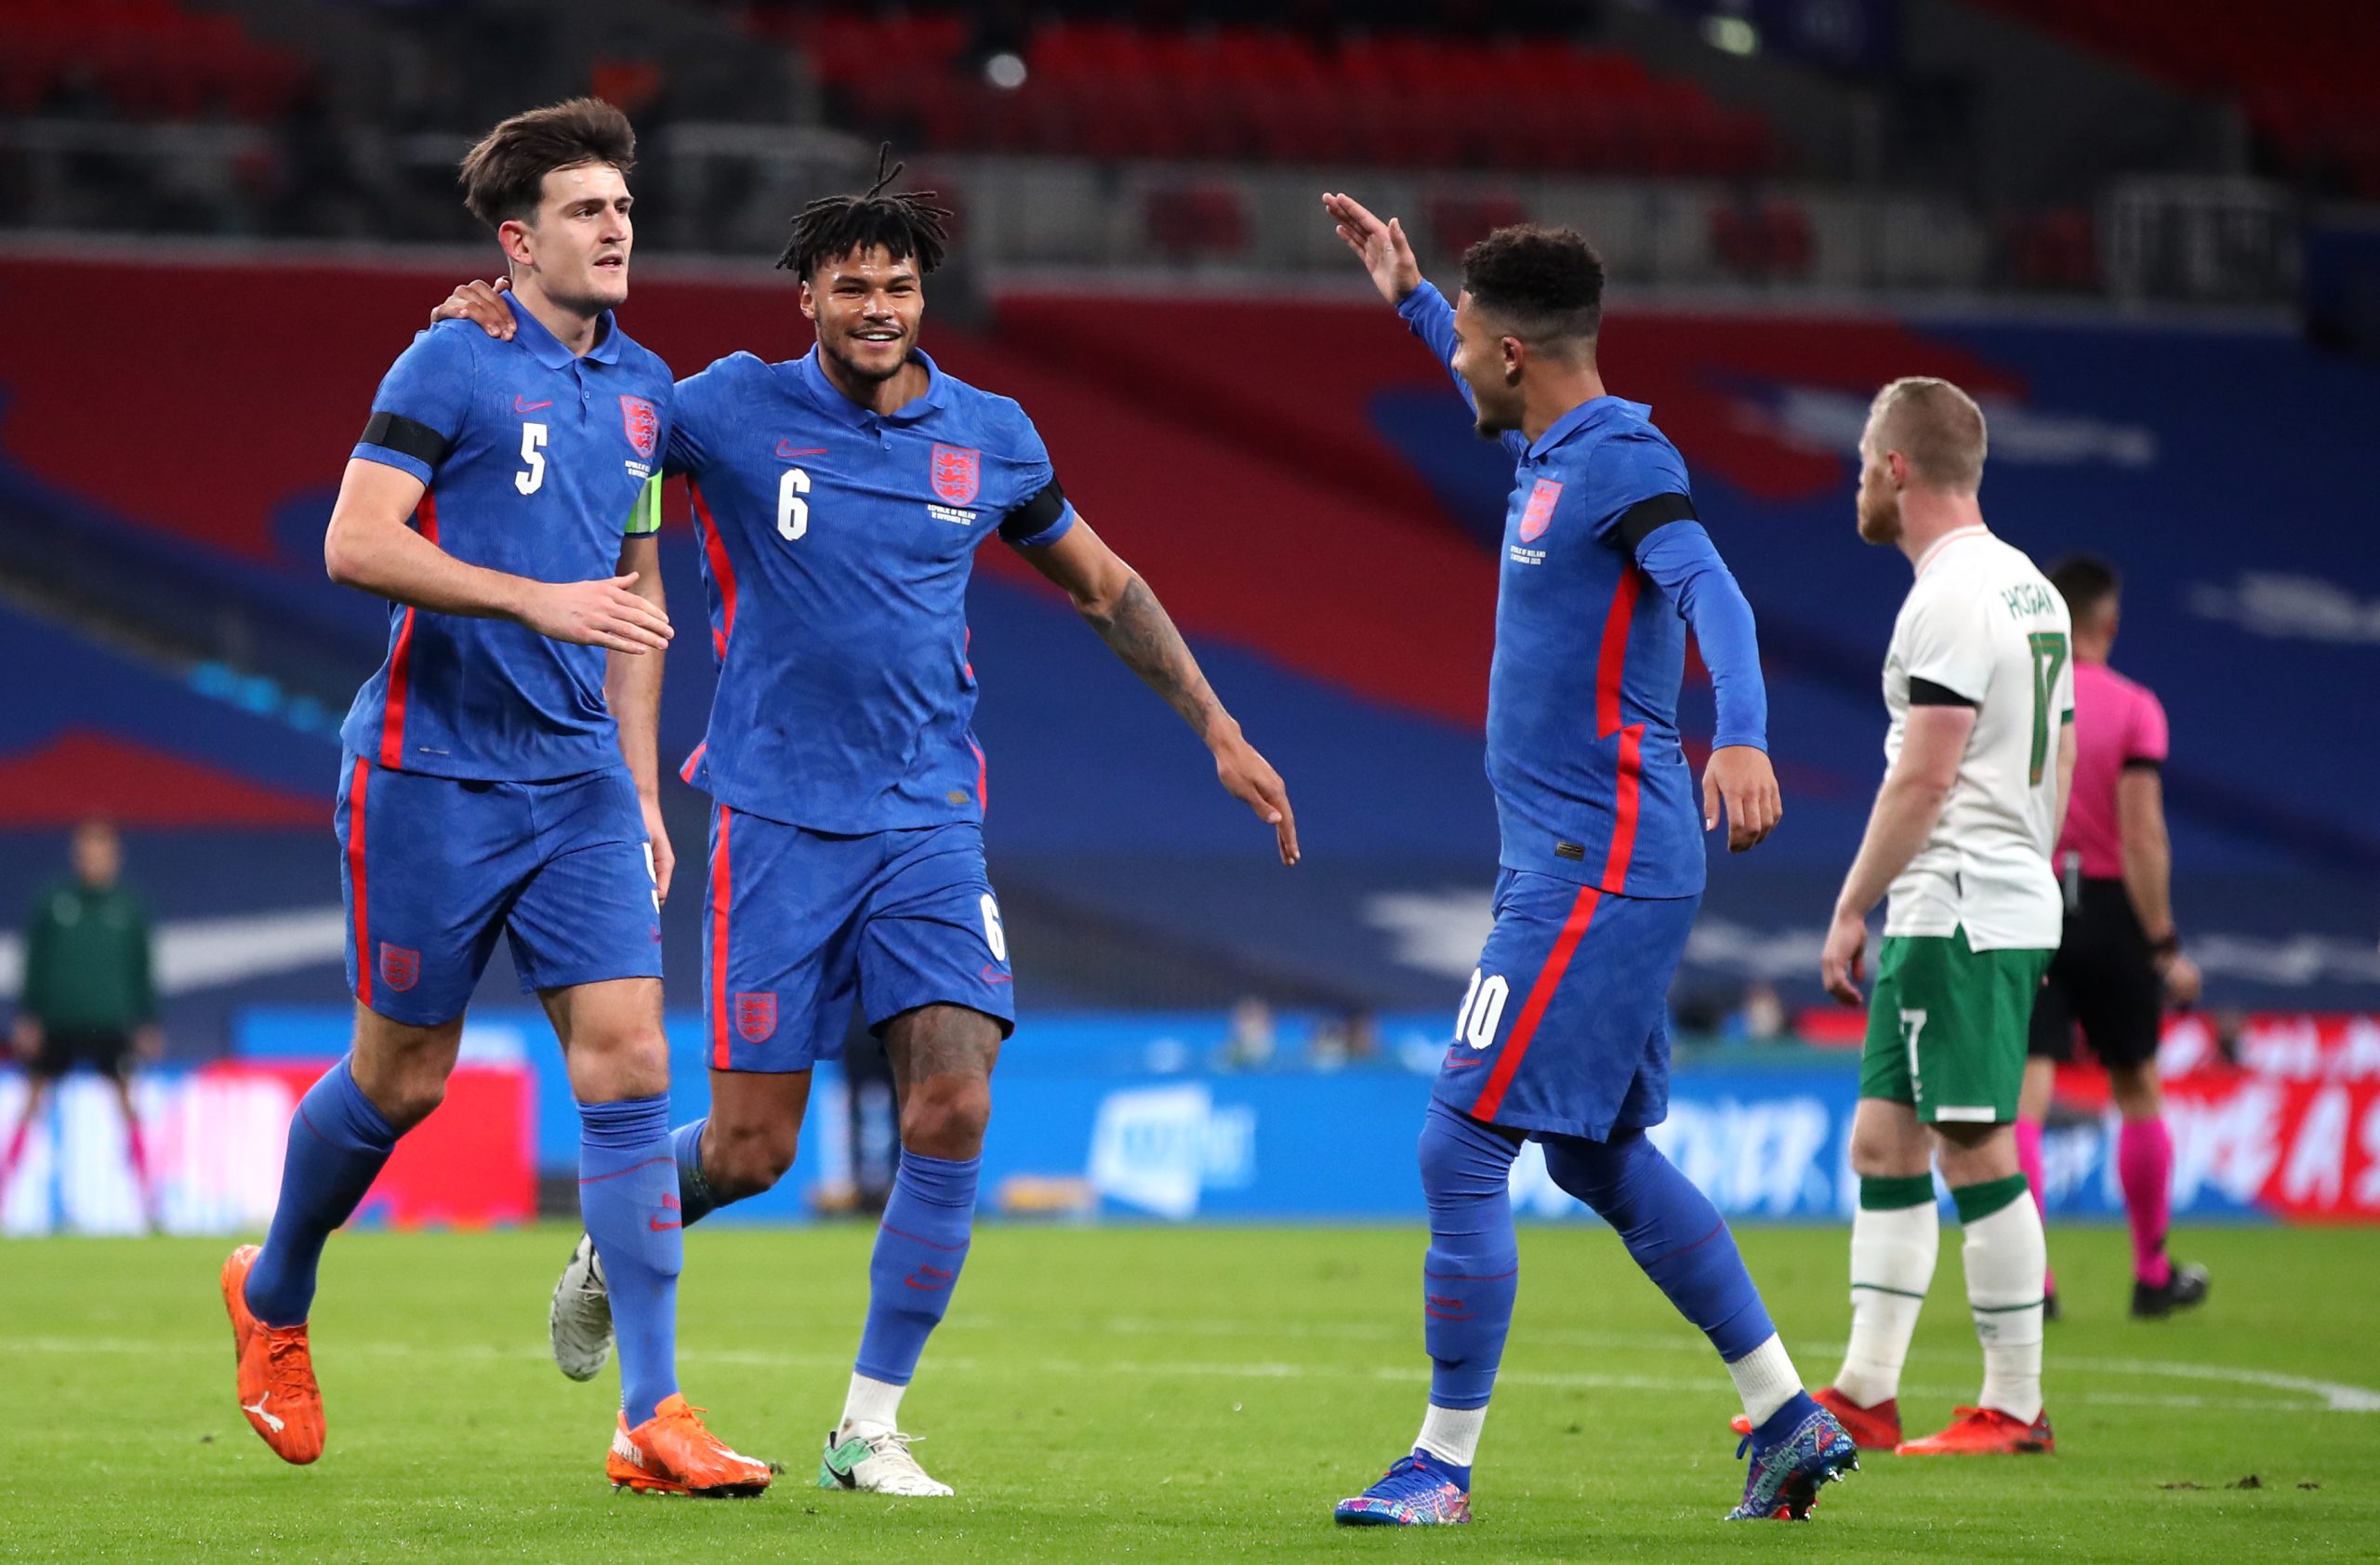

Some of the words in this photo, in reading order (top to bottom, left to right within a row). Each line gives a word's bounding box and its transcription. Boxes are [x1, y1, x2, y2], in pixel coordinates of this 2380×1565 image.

[514, 422, 548, 496] 5
[777, 468, 811, 541] 6
[2001, 583, 2056, 620] HOGAN
[2028, 631, 2067, 788] 17
[980, 894, 1006, 962] 6
[1455, 967, 1510, 1050] 10
